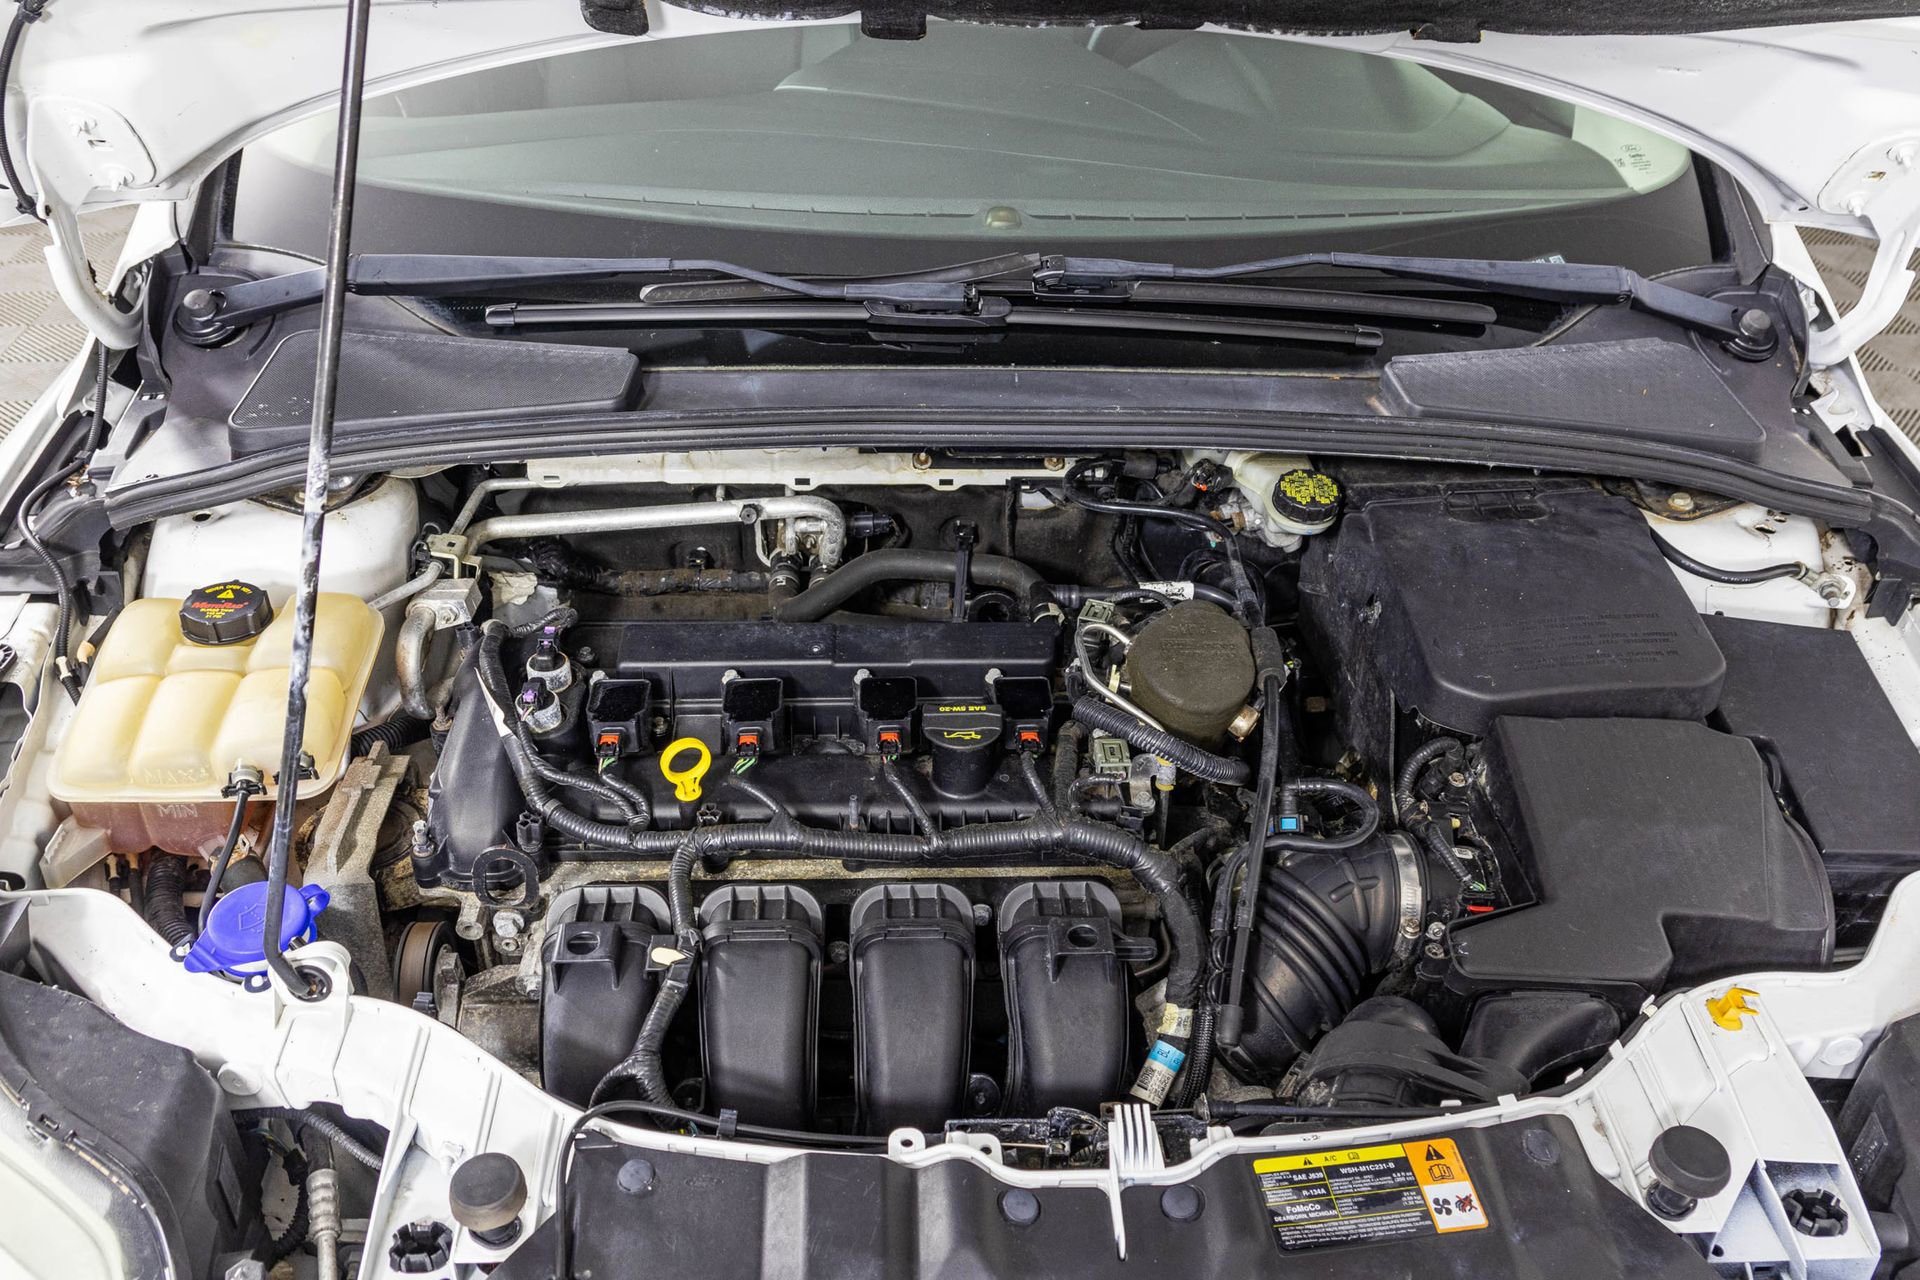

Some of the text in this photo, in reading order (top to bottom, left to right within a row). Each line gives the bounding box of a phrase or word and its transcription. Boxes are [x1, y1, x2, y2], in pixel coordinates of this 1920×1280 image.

[156, 803, 198, 819] MIN
[1292, 1173, 1308, 1181] SAE
[1302, 1188, 1327, 1197] R-134A
[1285, 1203, 1321, 1214] FoMoCo
[1308, 1209, 1338, 1218] MICHIGAN
